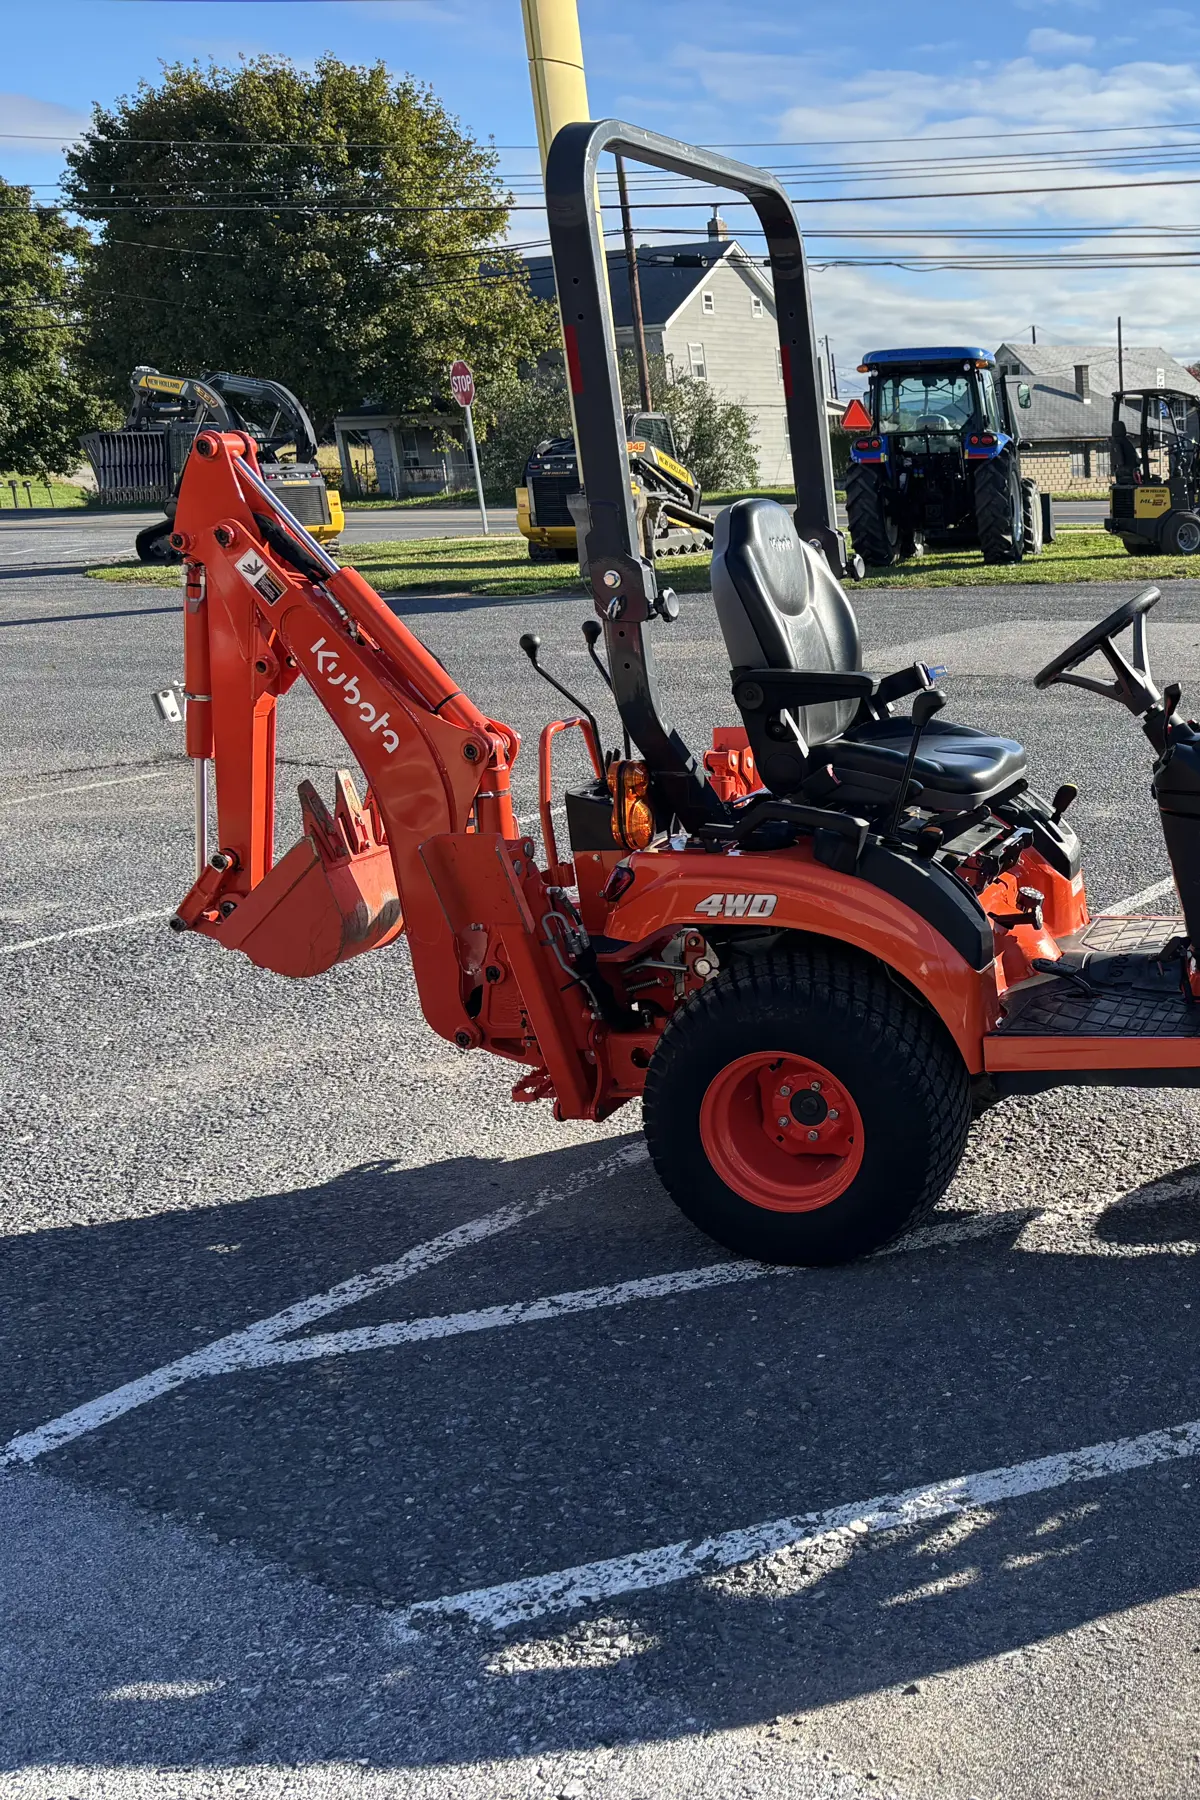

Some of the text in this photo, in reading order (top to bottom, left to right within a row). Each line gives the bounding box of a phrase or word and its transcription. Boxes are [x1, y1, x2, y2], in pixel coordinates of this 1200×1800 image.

[452, 375, 471, 392] STOP
[310, 637, 400, 754] Kubota
[694, 893, 778, 918] 4WD
